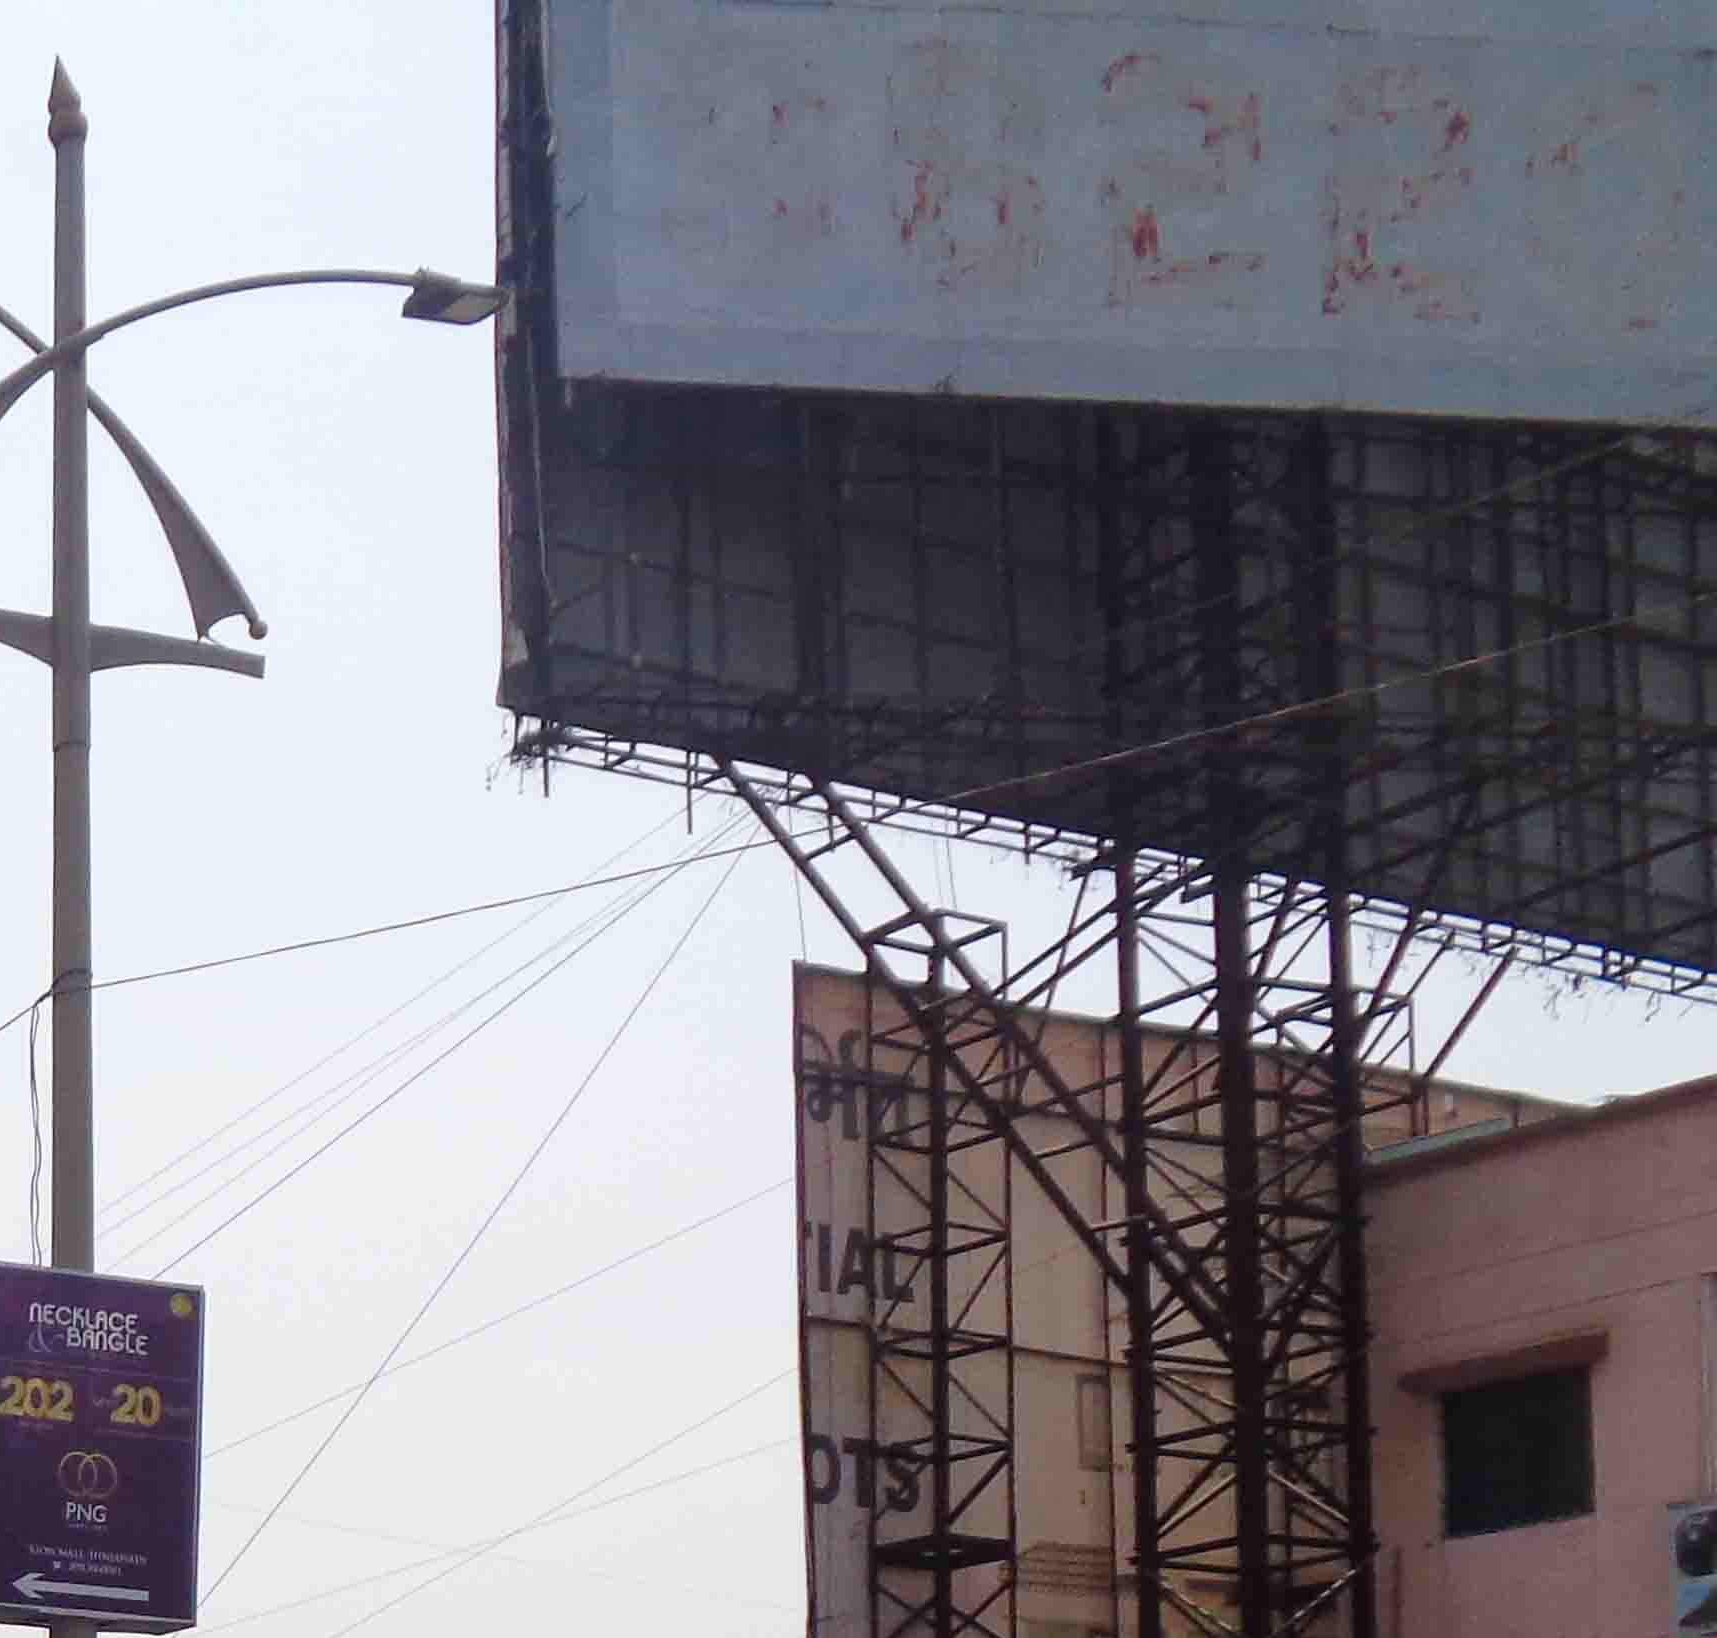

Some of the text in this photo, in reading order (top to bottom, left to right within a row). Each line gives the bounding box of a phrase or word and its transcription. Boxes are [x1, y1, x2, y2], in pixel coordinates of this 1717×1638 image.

[805, 1222, 915, 1304] IAL
[29, 1302, 139, 1335] NECKLACE
[66, 1326, 149, 1356] BANGLE
[65, 1501, 108, 1523] PNG
